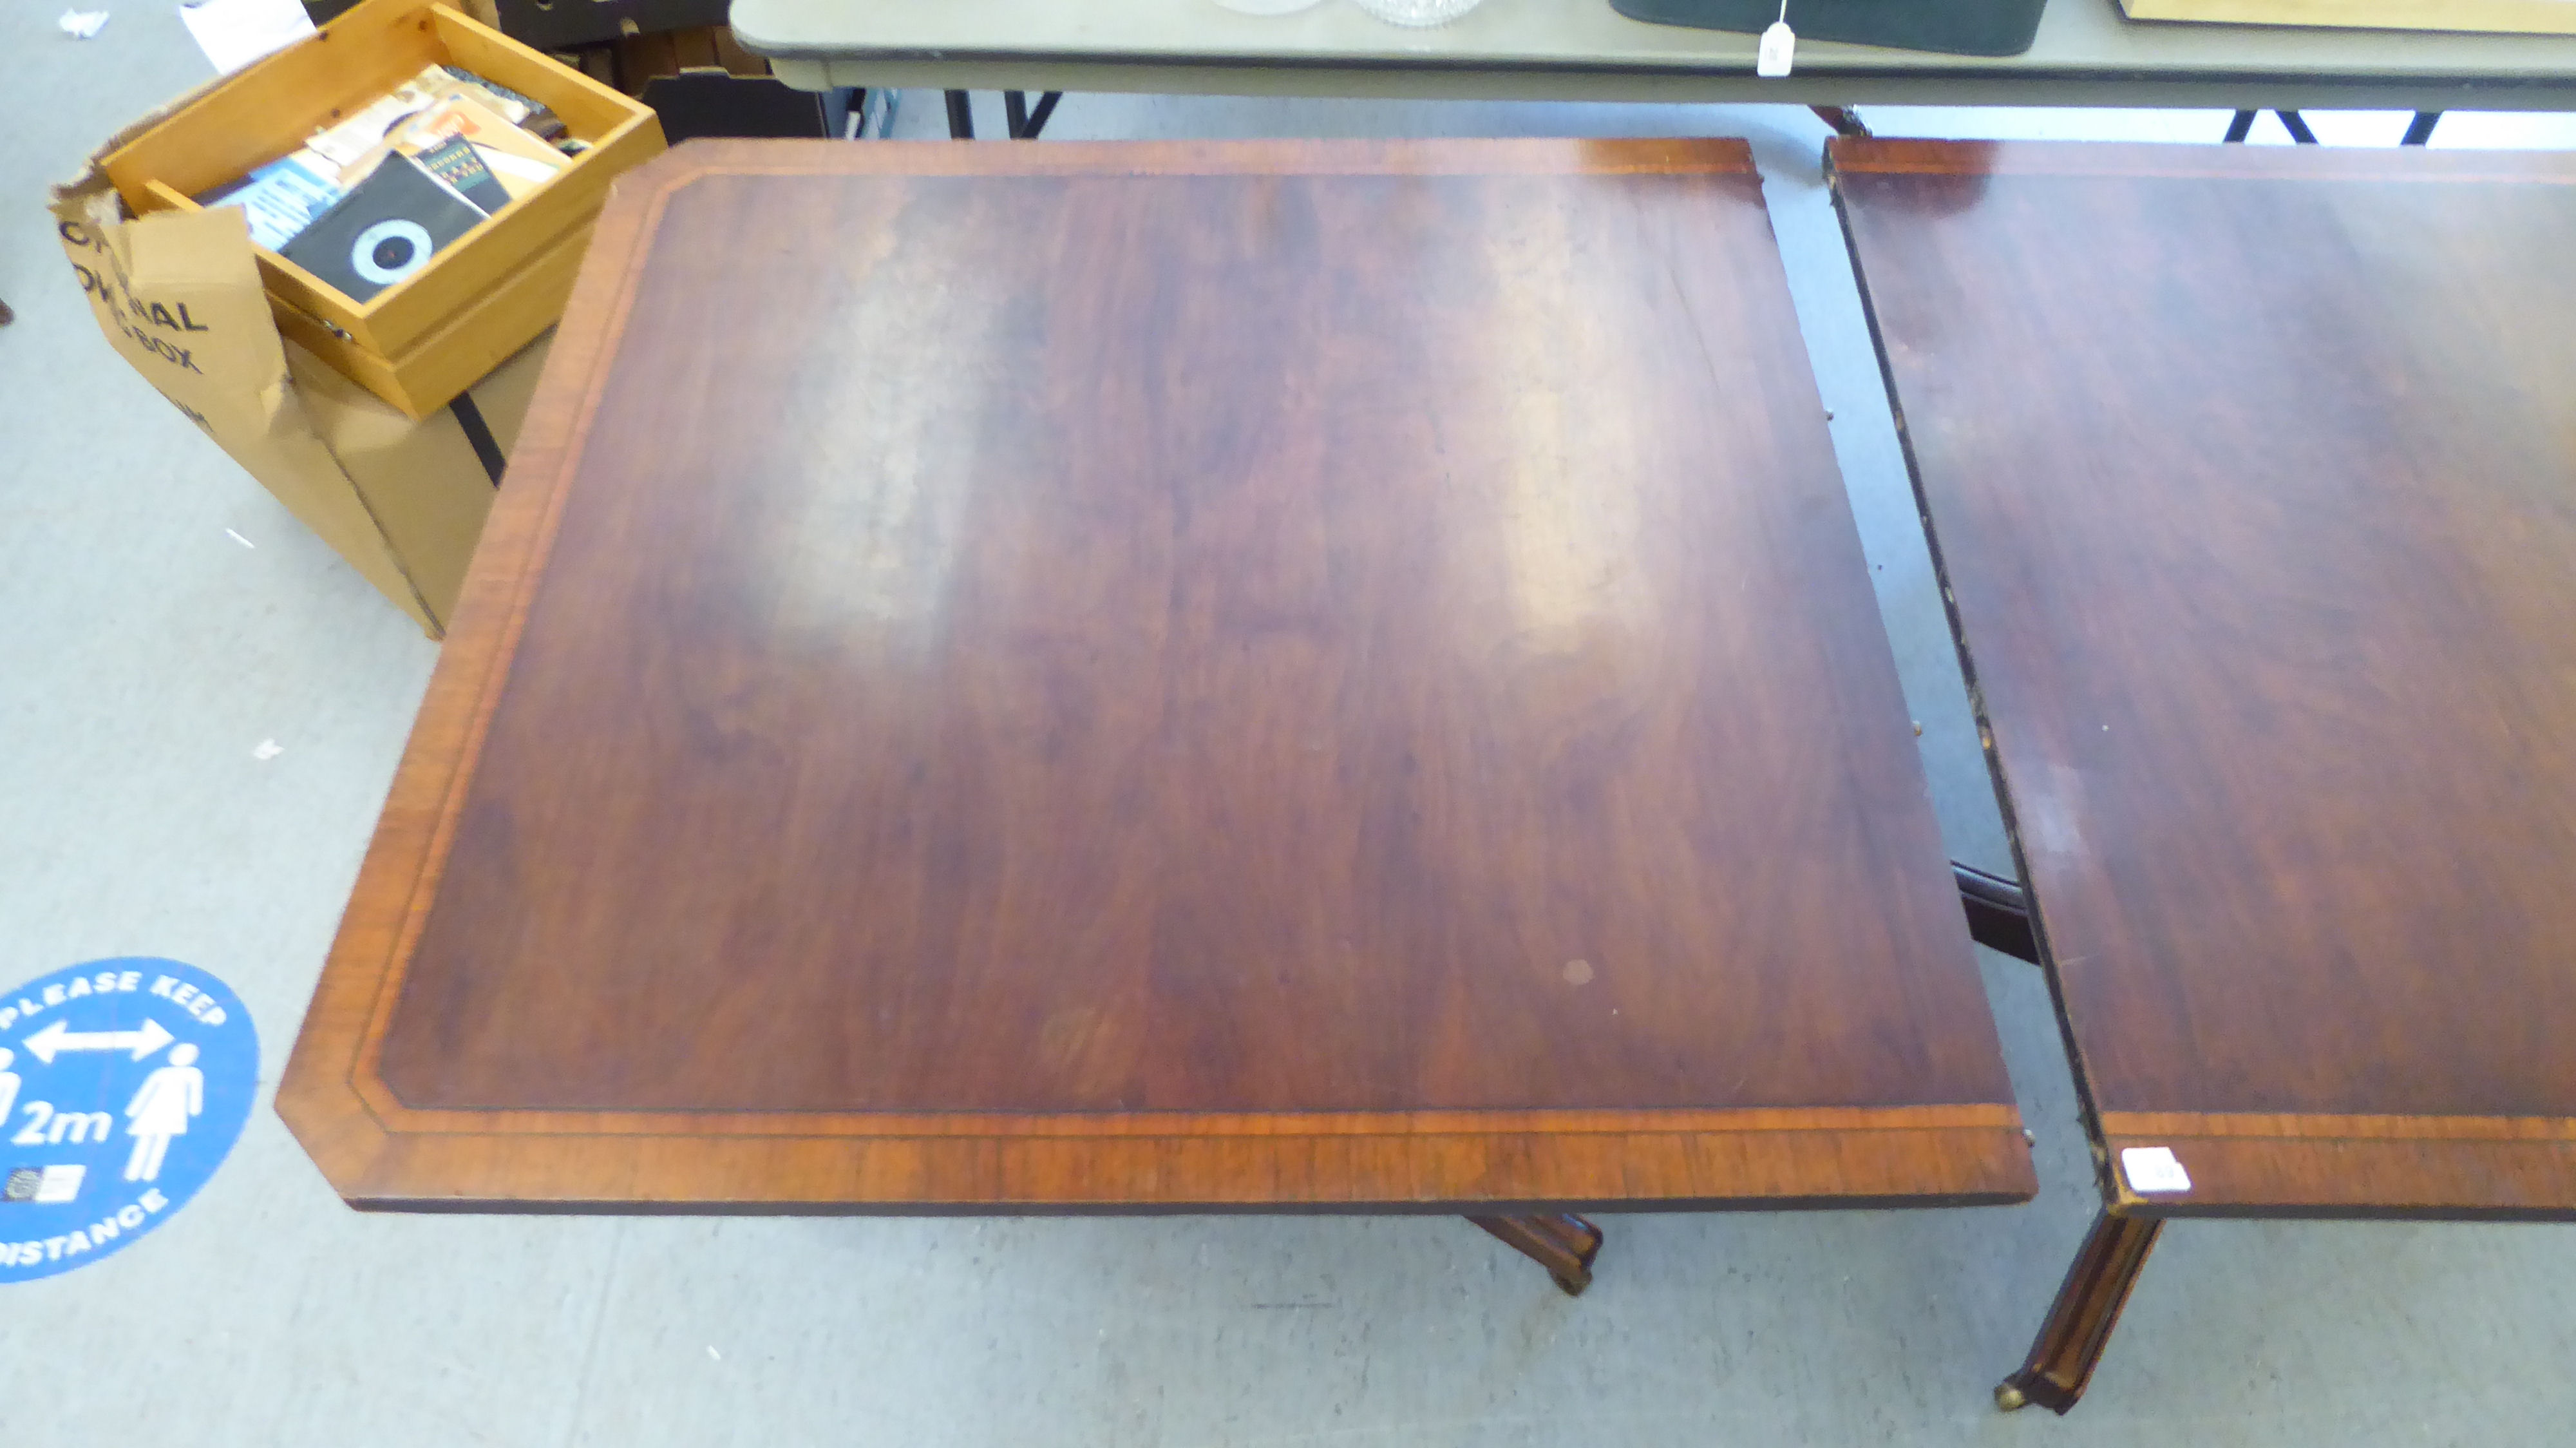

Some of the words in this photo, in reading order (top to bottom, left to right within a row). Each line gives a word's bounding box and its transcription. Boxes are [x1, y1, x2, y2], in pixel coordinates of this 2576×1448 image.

[0, 971, 143, 1030] PLEASE
[150, 974, 227, 1027] KEEP
[10, 1100, 113, 1145] 2m
